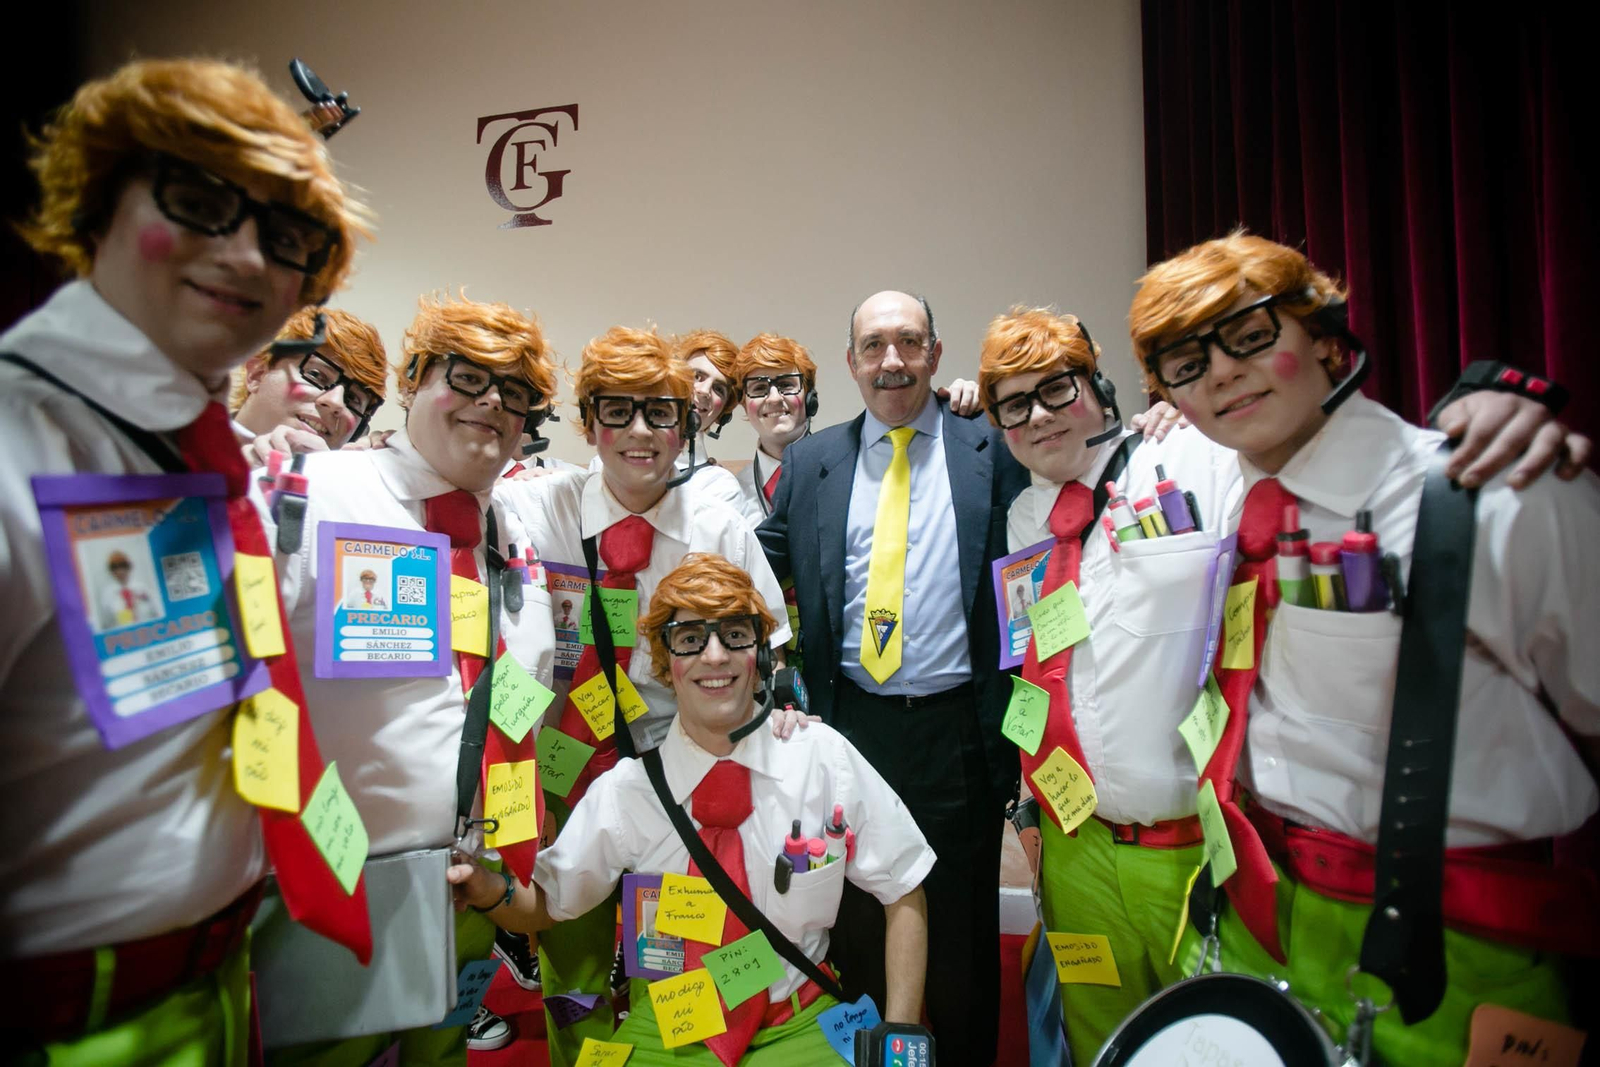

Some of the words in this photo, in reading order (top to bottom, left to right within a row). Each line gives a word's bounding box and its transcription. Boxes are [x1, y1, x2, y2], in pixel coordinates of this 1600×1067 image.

[344, 542, 408, 558] CARMELO
[410, 548, 431, 561] S.L.
[1006, 560, 1040, 581] CARMELO
[553, 579, 587, 591] CARME
[346, 612, 428, 626] PRECARIO
[372, 628, 407, 637] EMILIO
[366, 641, 412, 650] SÁNCHEZ
[565, 643, 584, 651] EMIL
[367, 652, 412, 661] BECARIO
[560, 651, 580, 659] SÁNC
[511, 682, 519, 692] a
[577, 690, 594, 704] Voy
[597, 682, 608, 692] a
[583, 695, 611, 717] hacer
[501, 695, 536, 731] Turquía
[1018, 708, 1027, 718] a
[1039, 772, 1056, 786] Voy
[1056, 766, 1064, 774] a
[1047, 782, 1069, 802] hacer
[1069, 772, 1080, 784] lo
[1057, 796, 1071, 812] que
[686, 900, 696, 908] a
[664, 910, 706, 921] Franco
[665, 950, 684, 959] EMIL
[661, 958, 684, 966] SÁNC
[662, 965, 684, 973] BECA
[833, 1020, 844, 1032] no
[842, 1032, 852, 1044] ni
[908, 1041, 918, 1067] Jefe
